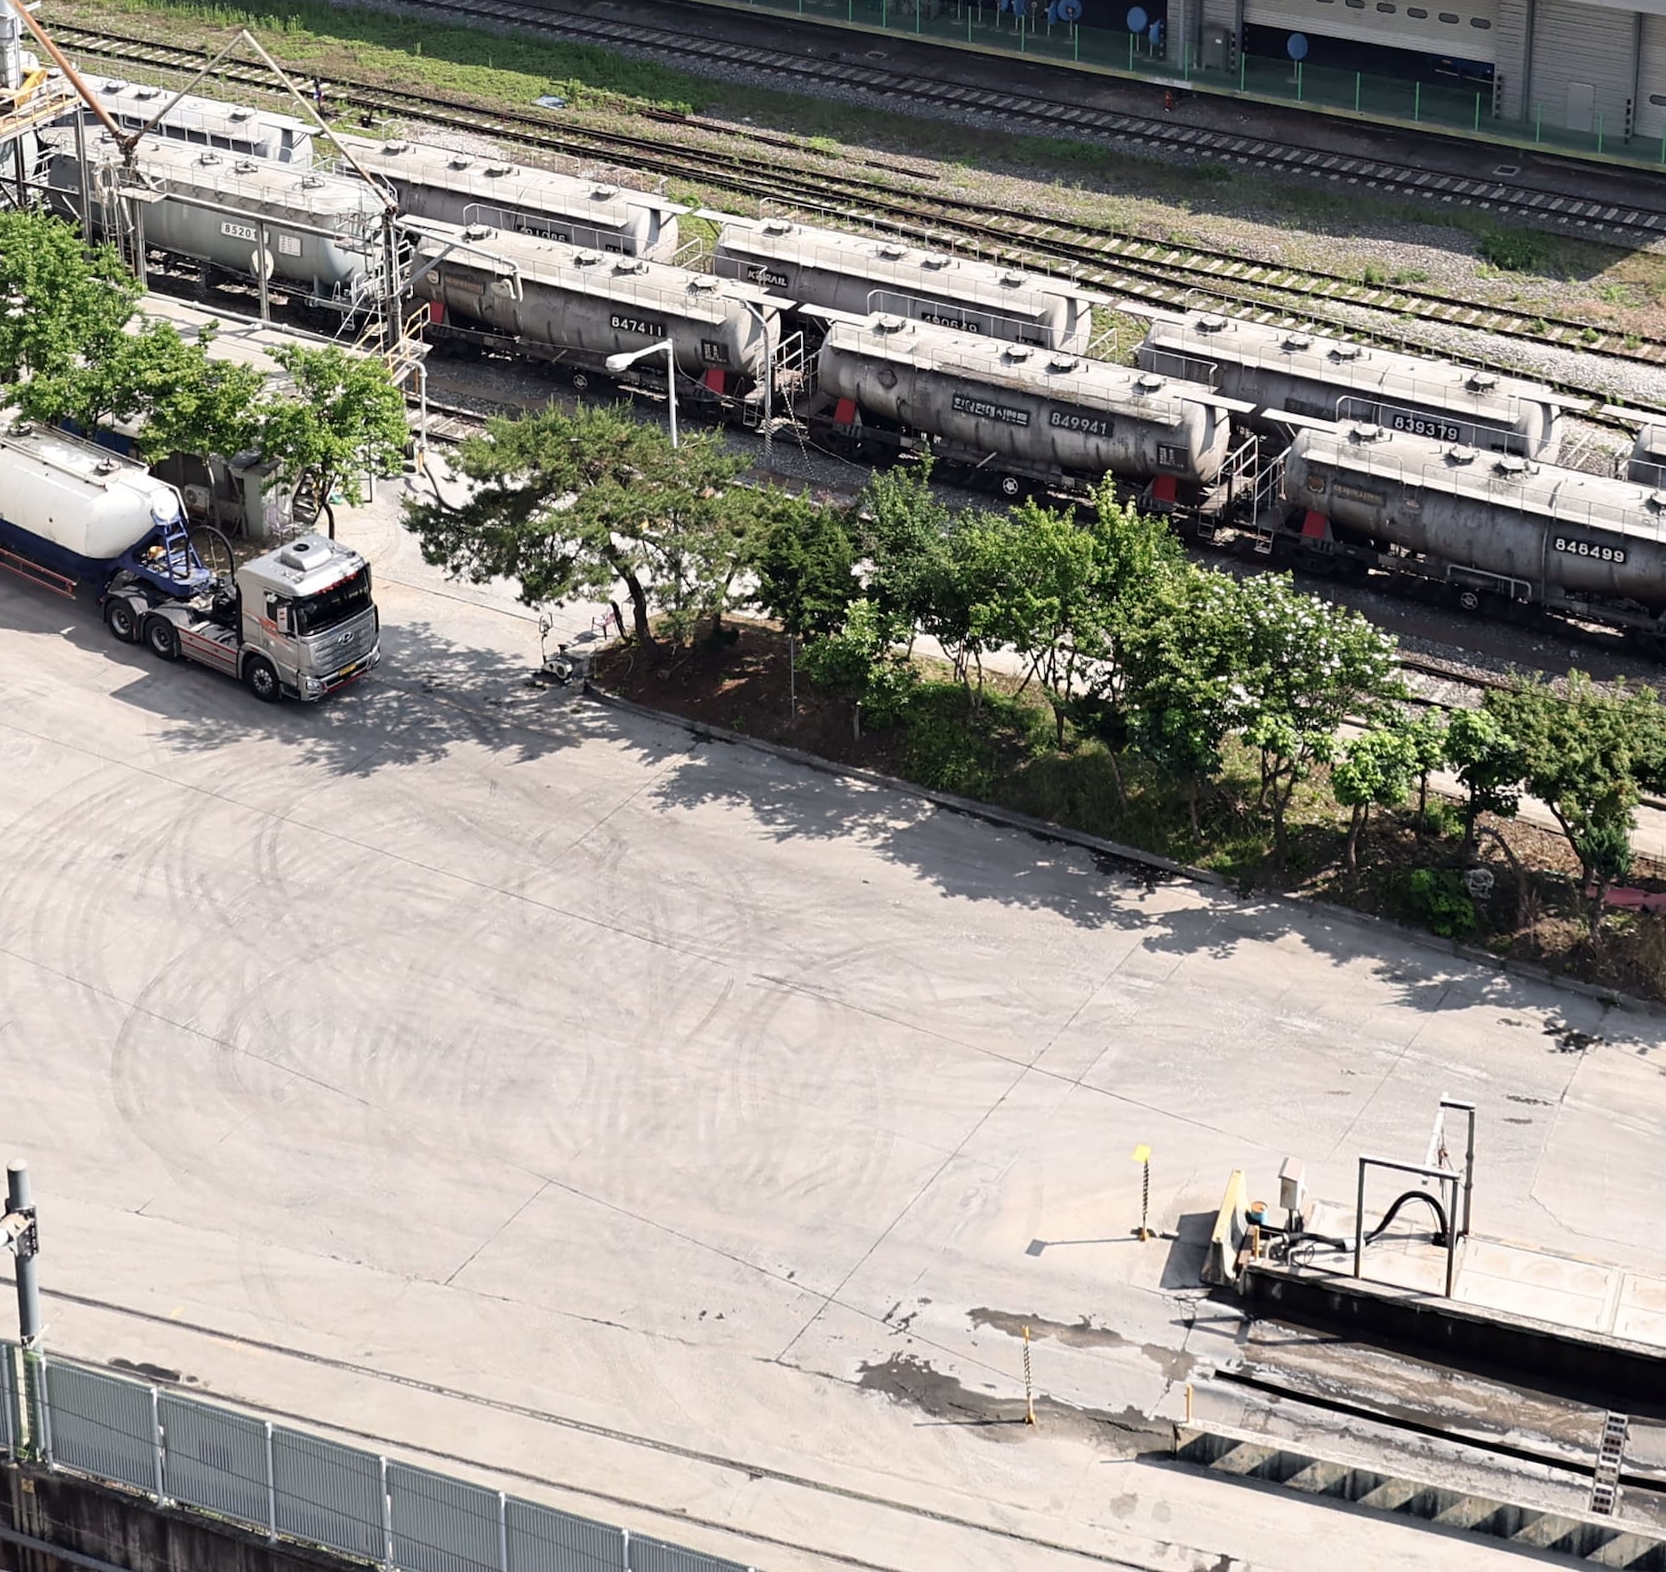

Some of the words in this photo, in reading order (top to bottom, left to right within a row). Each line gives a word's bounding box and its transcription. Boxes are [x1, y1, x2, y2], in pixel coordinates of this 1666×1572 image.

[224, 224, 258, 238] 85201
[611, 316, 662, 337] 847411
[1051, 412, 1107, 435] 849941
[1394, 417, 1458, 441] 839379
[1555, 538, 1625, 563] 848499
